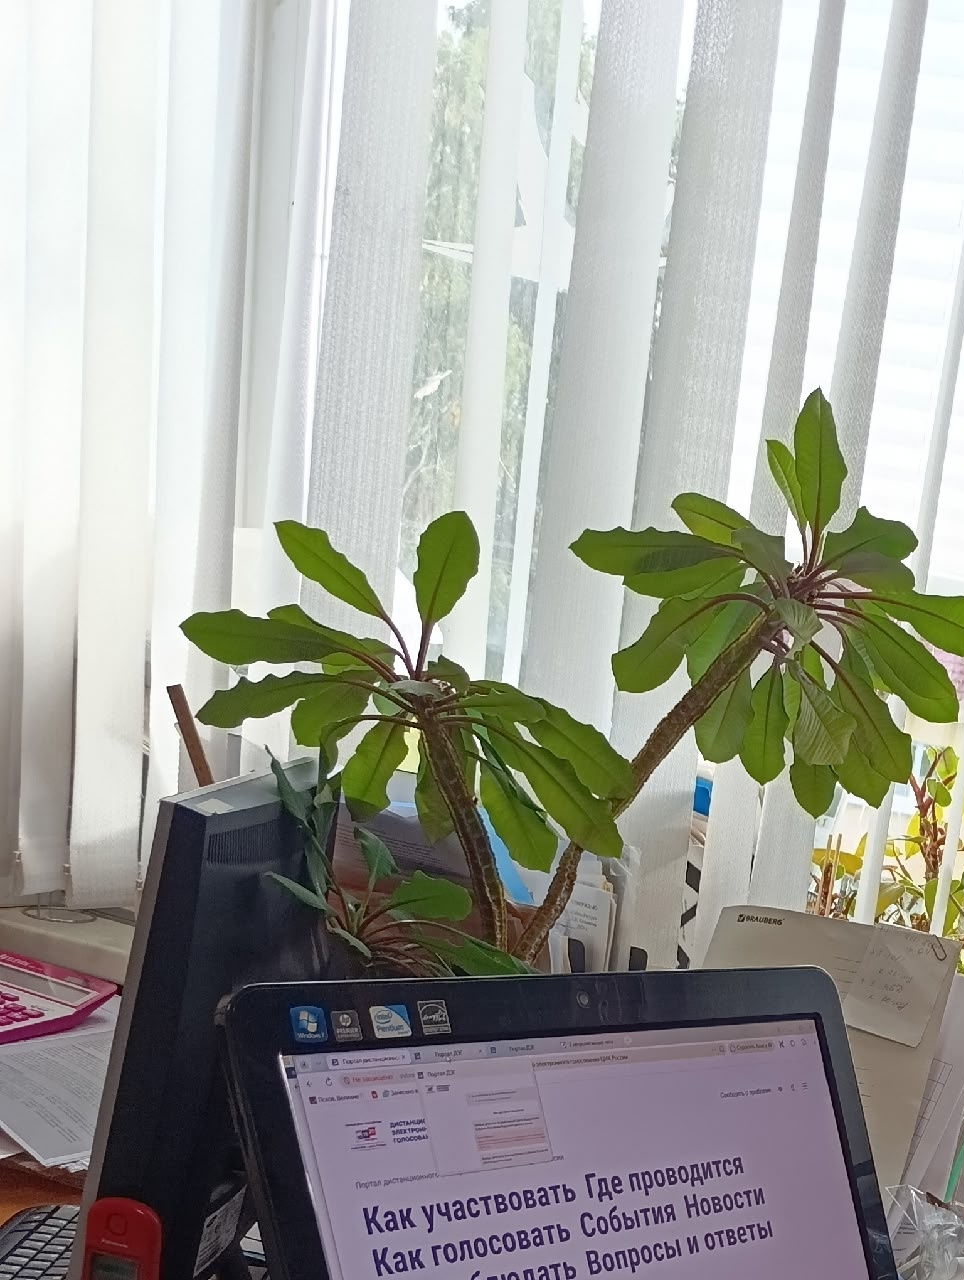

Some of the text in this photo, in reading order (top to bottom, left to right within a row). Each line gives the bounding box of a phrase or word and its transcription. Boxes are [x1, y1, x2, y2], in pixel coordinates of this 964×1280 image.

[744, 915, 784, 926] BRAUBERG
[376, 1024, 405, 1033] Pentium
[355, 1176, 383, 1190] Портал
[362, 1156, 744, 1235] Как участвовать Где проводится
[372, 1185, 766, 1277] Как голосовать События Новости
[586, 1240, 683, 1276] Вопросы
[686, 1233, 701, 1256] и
[704, 1220, 774, 1250] ответы
